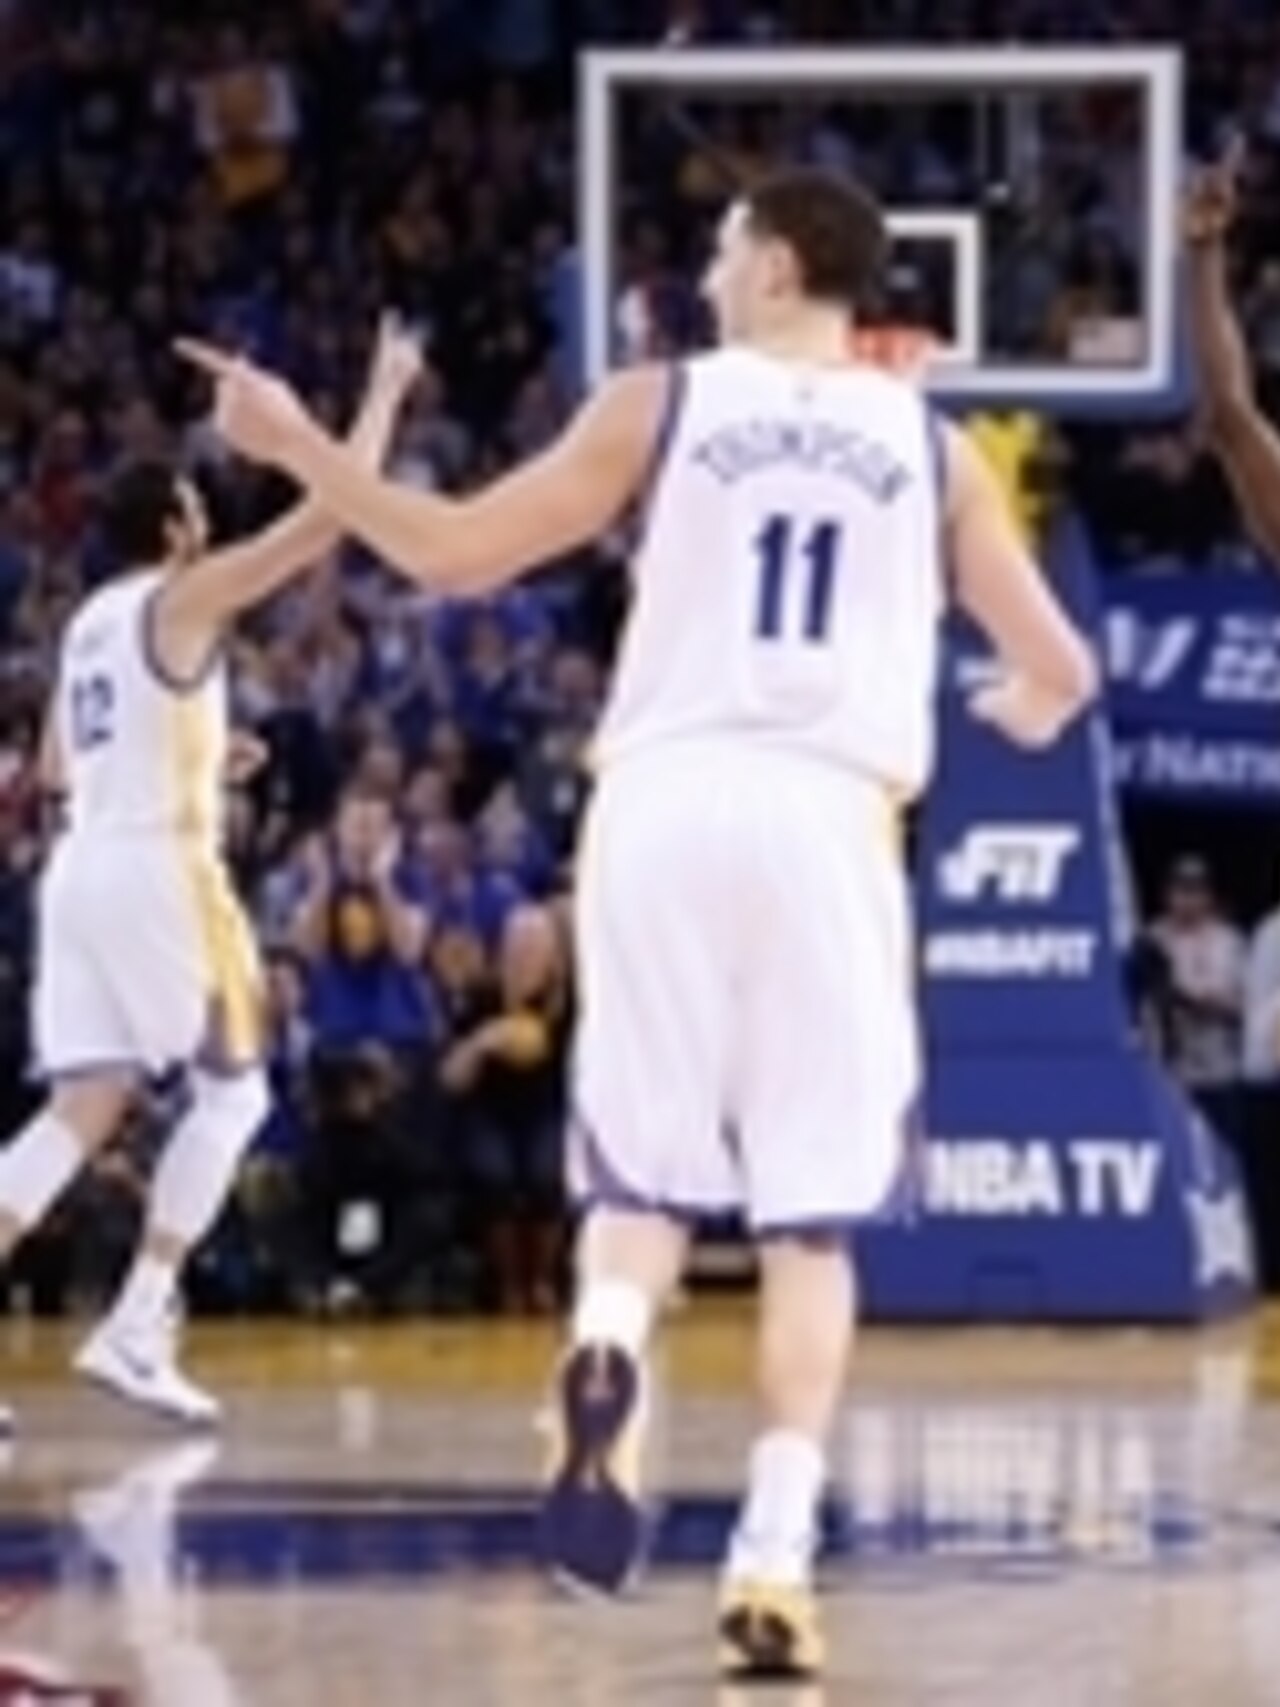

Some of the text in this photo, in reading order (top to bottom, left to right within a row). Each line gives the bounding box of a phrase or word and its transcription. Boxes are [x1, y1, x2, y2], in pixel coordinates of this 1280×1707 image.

[754, 514, 842, 645] 11
[926, 1137, 1164, 1217] NBA TV
